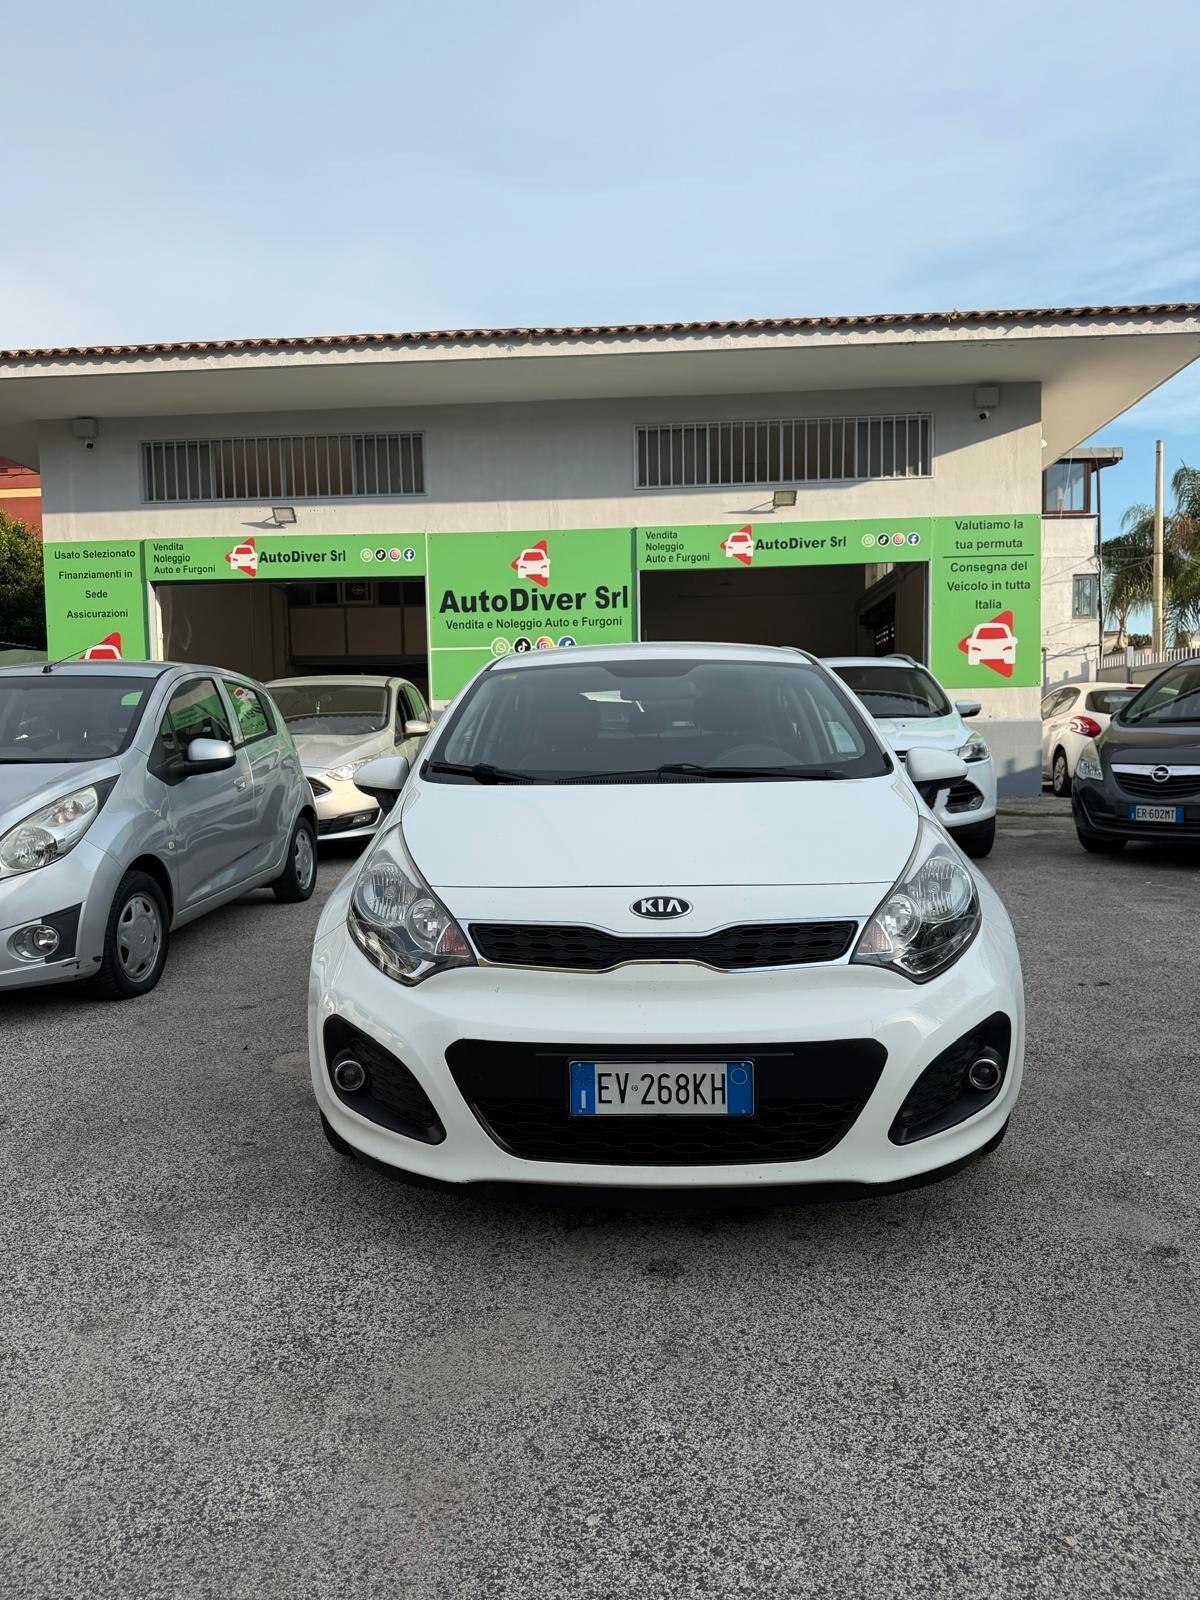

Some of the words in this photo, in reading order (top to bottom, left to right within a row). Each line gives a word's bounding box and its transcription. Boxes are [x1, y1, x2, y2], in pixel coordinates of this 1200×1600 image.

[955, 520, 1010, 530] Valutiamo
[1014, 519, 1024, 529] la
[645, 530, 678, 540] Vendita
[153, 542, 184, 551] Vendita
[645, 541, 684, 552] Noleggio
[755, 537, 826, 550] AutoDiver
[830, 536, 847, 547] Srl
[955, 540, 973, 549] tua
[976, 538, 1023, 551] permuta
[54, 551, 81, 560] Usato
[82, 549, 136, 559] Selezionato
[153, 553, 191, 563] Noleggio
[258, 551, 327, 563] AutoDiver
[330, 549, 346, 562] Srl
[645, 554, 666, 564] Auto
[668, 555, 674, 563] e
[676, 552, 710, 564] Furgoni
[153, 565, 174, 574] Auto
[182, 564, 216, 575] Furgoni
[950, 562, 1007, 574] Consegna
[1010, 561, 1028, 571] del
[58, 570, 122, 580] Finanziamenti
[124, 569, 133, 578] in
[947, 581, 988, 592] Veicolo
[991, 580, 1002, 590] in
[1005, 580, 1031, 590] tutta
[85, 590, 108, 599] Sede
[439, 587, 587, 614] AutoDiver
[595, 585, 629, 609] Srl
[975, 599, 1002, 609] Italia
[66, 609, 129, 619] Assicurazioni
[445, 620, 484, 630] Vendita
[496, 619, 543, 631] Noleggio
[545, 618, 570, 628] Auto
[572, 619, 579, 627] e
[581, 616, 622, 629] Furgoni
[641, 899, 682, 913] KIA
